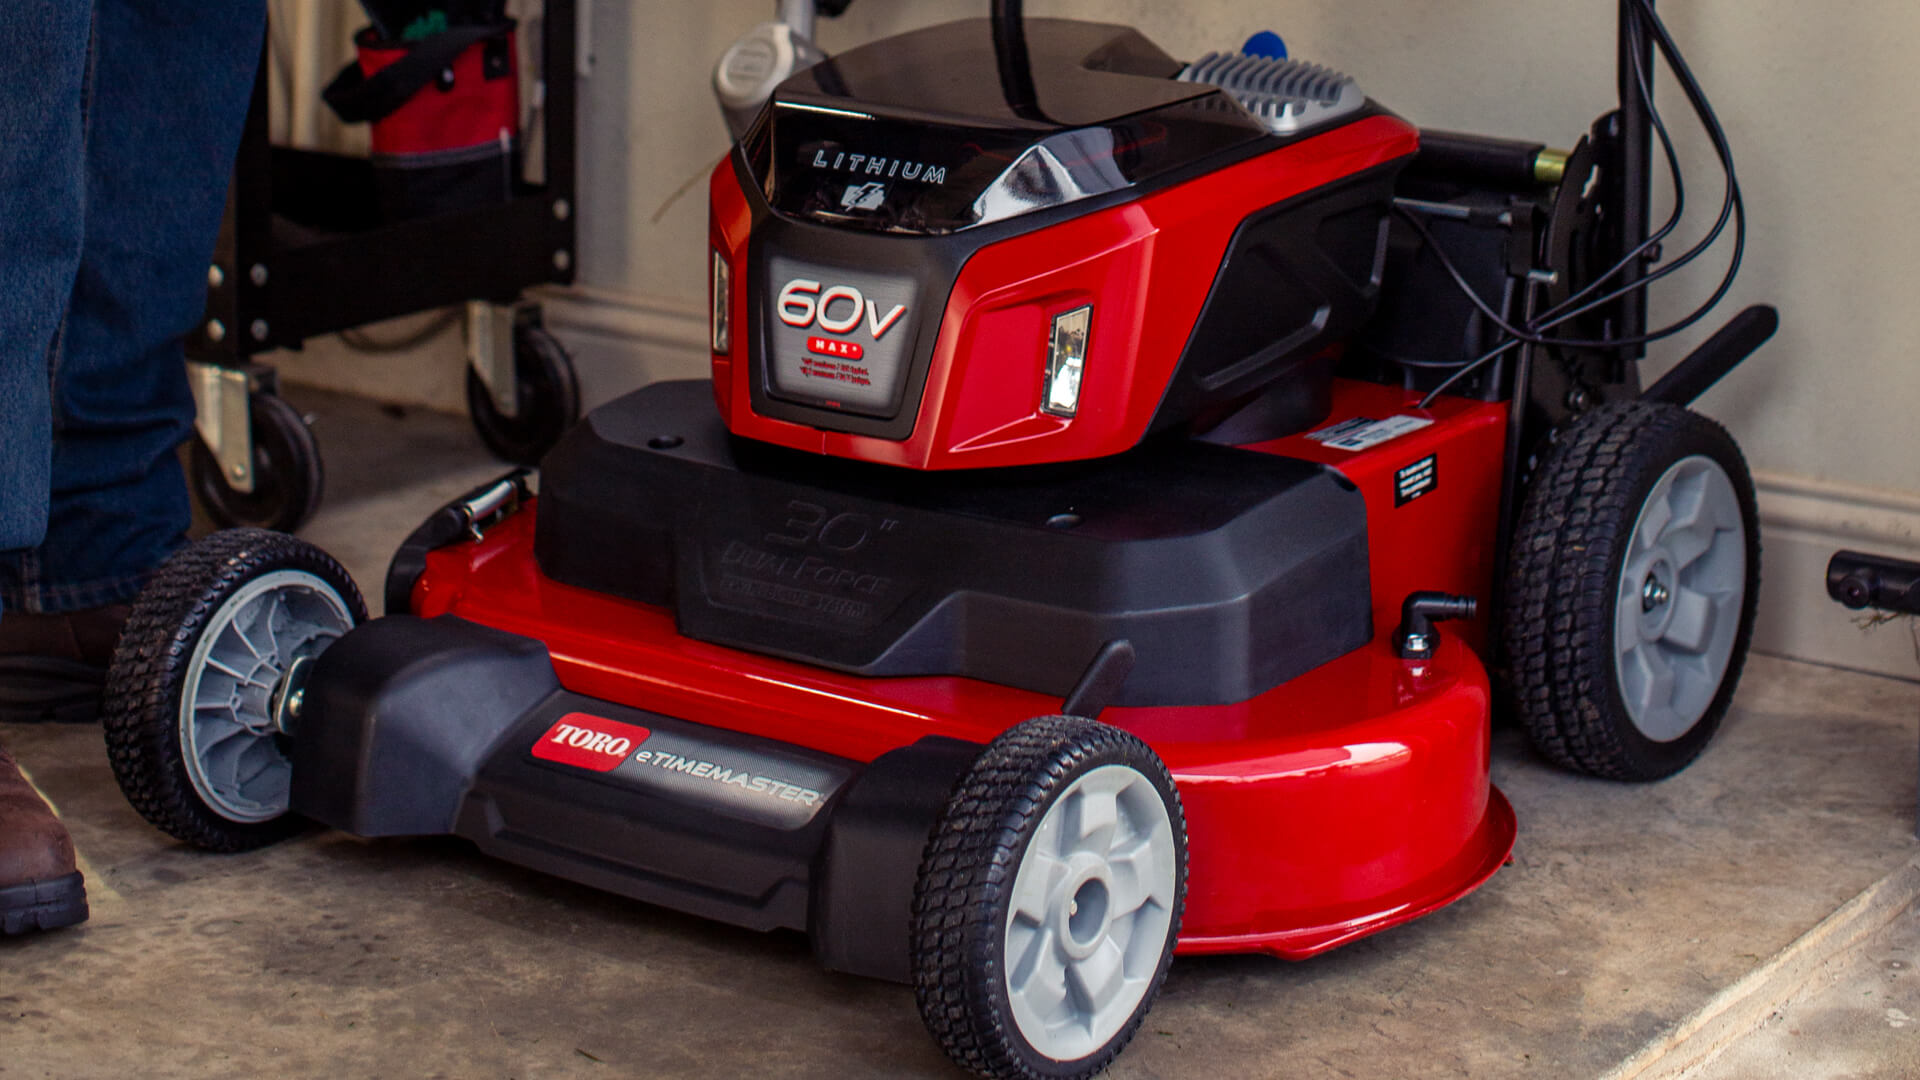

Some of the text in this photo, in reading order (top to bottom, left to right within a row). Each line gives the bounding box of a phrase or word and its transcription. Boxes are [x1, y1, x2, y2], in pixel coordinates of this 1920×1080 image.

[813, 149, 946, 184] LITHIUM
[551, 723, 630, 756] TORO
[635, 750, 822, 806] eTIMEMASTER
